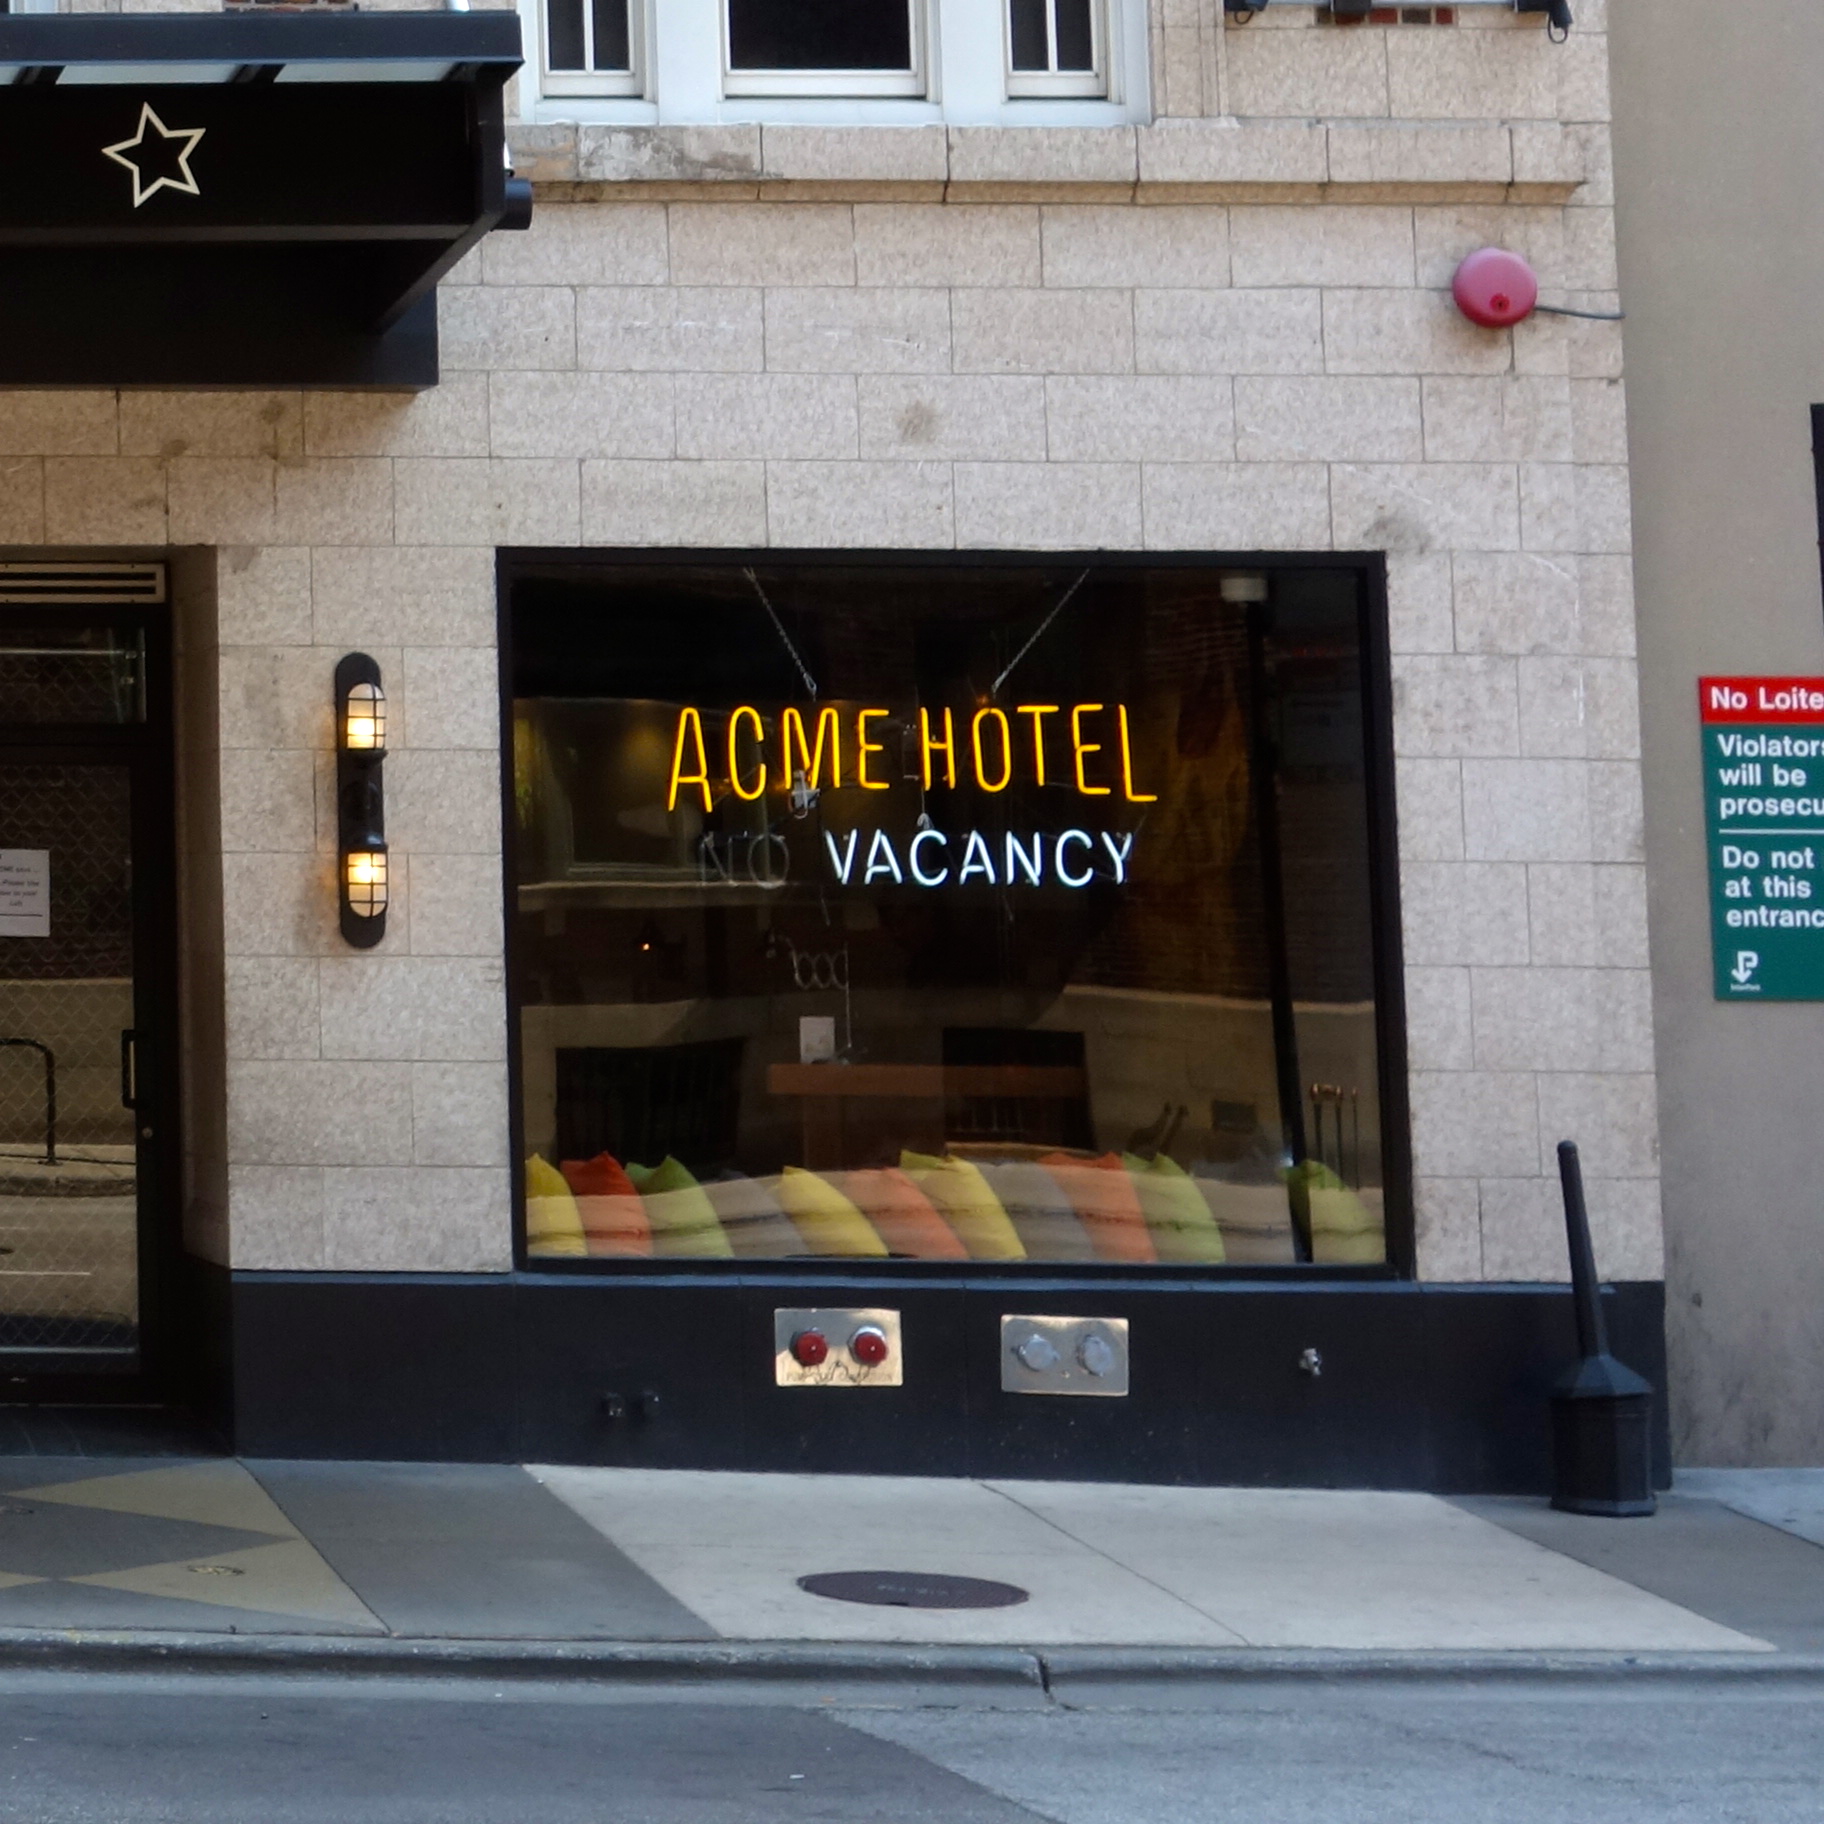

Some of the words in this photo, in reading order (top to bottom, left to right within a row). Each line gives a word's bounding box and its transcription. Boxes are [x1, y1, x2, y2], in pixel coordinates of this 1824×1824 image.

[1710, 686, 1748, 710] No
[1717, 734, 1824, 758] Violator
[667, 706, 890, 813] ACME
[919, 704, 1159, 803] HOTEL
[1719, 763, 1762, 786] will
[1772, 763, 1807, 787] be
[825, 828, 1133, 887] VACANCY
[1722, 845, 1760, 869] Do
[1770, 847, 1815, 869] not
[1724, 876, 1752, 898] at
[1763, 875, 1812, 898] this
